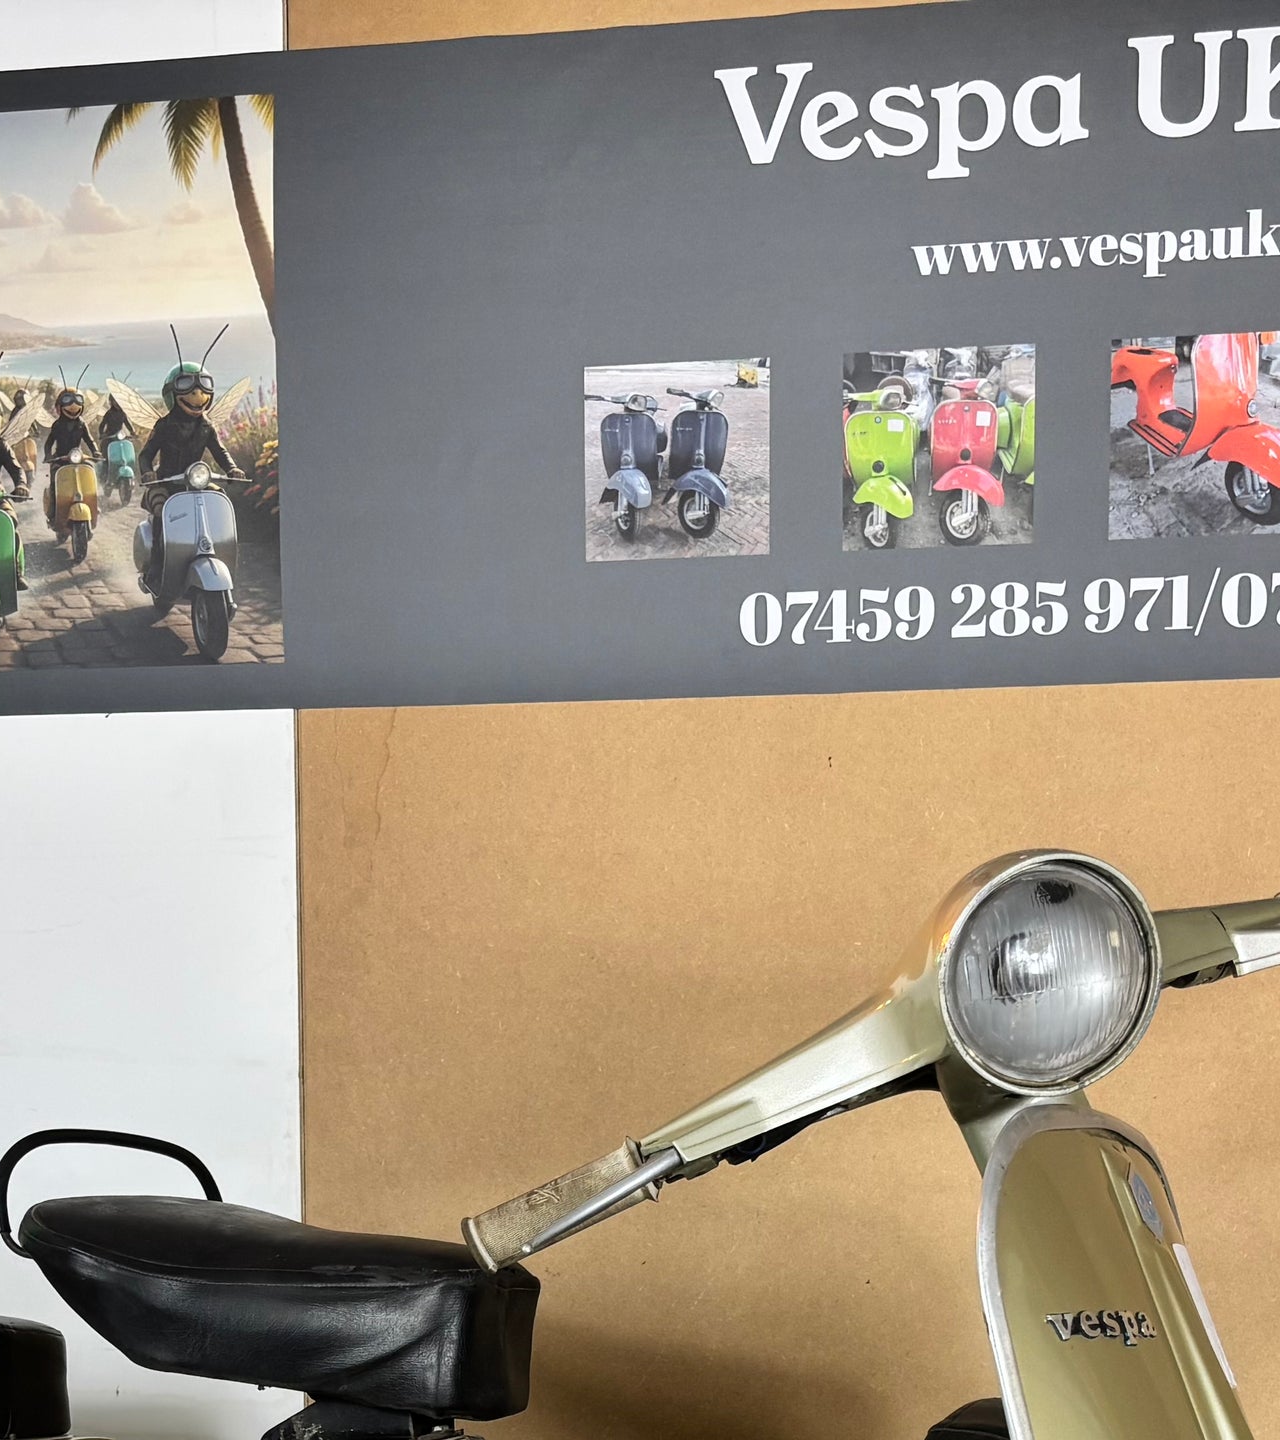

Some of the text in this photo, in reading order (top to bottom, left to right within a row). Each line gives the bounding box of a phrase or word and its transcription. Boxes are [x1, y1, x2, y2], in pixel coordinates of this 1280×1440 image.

[713, 61, 1090, 180] Vespa
[739, 583, 936, 648] 07459
[950, 579, 1070, 640] 285
[1044, 1309, 1158, 1347] vespa
